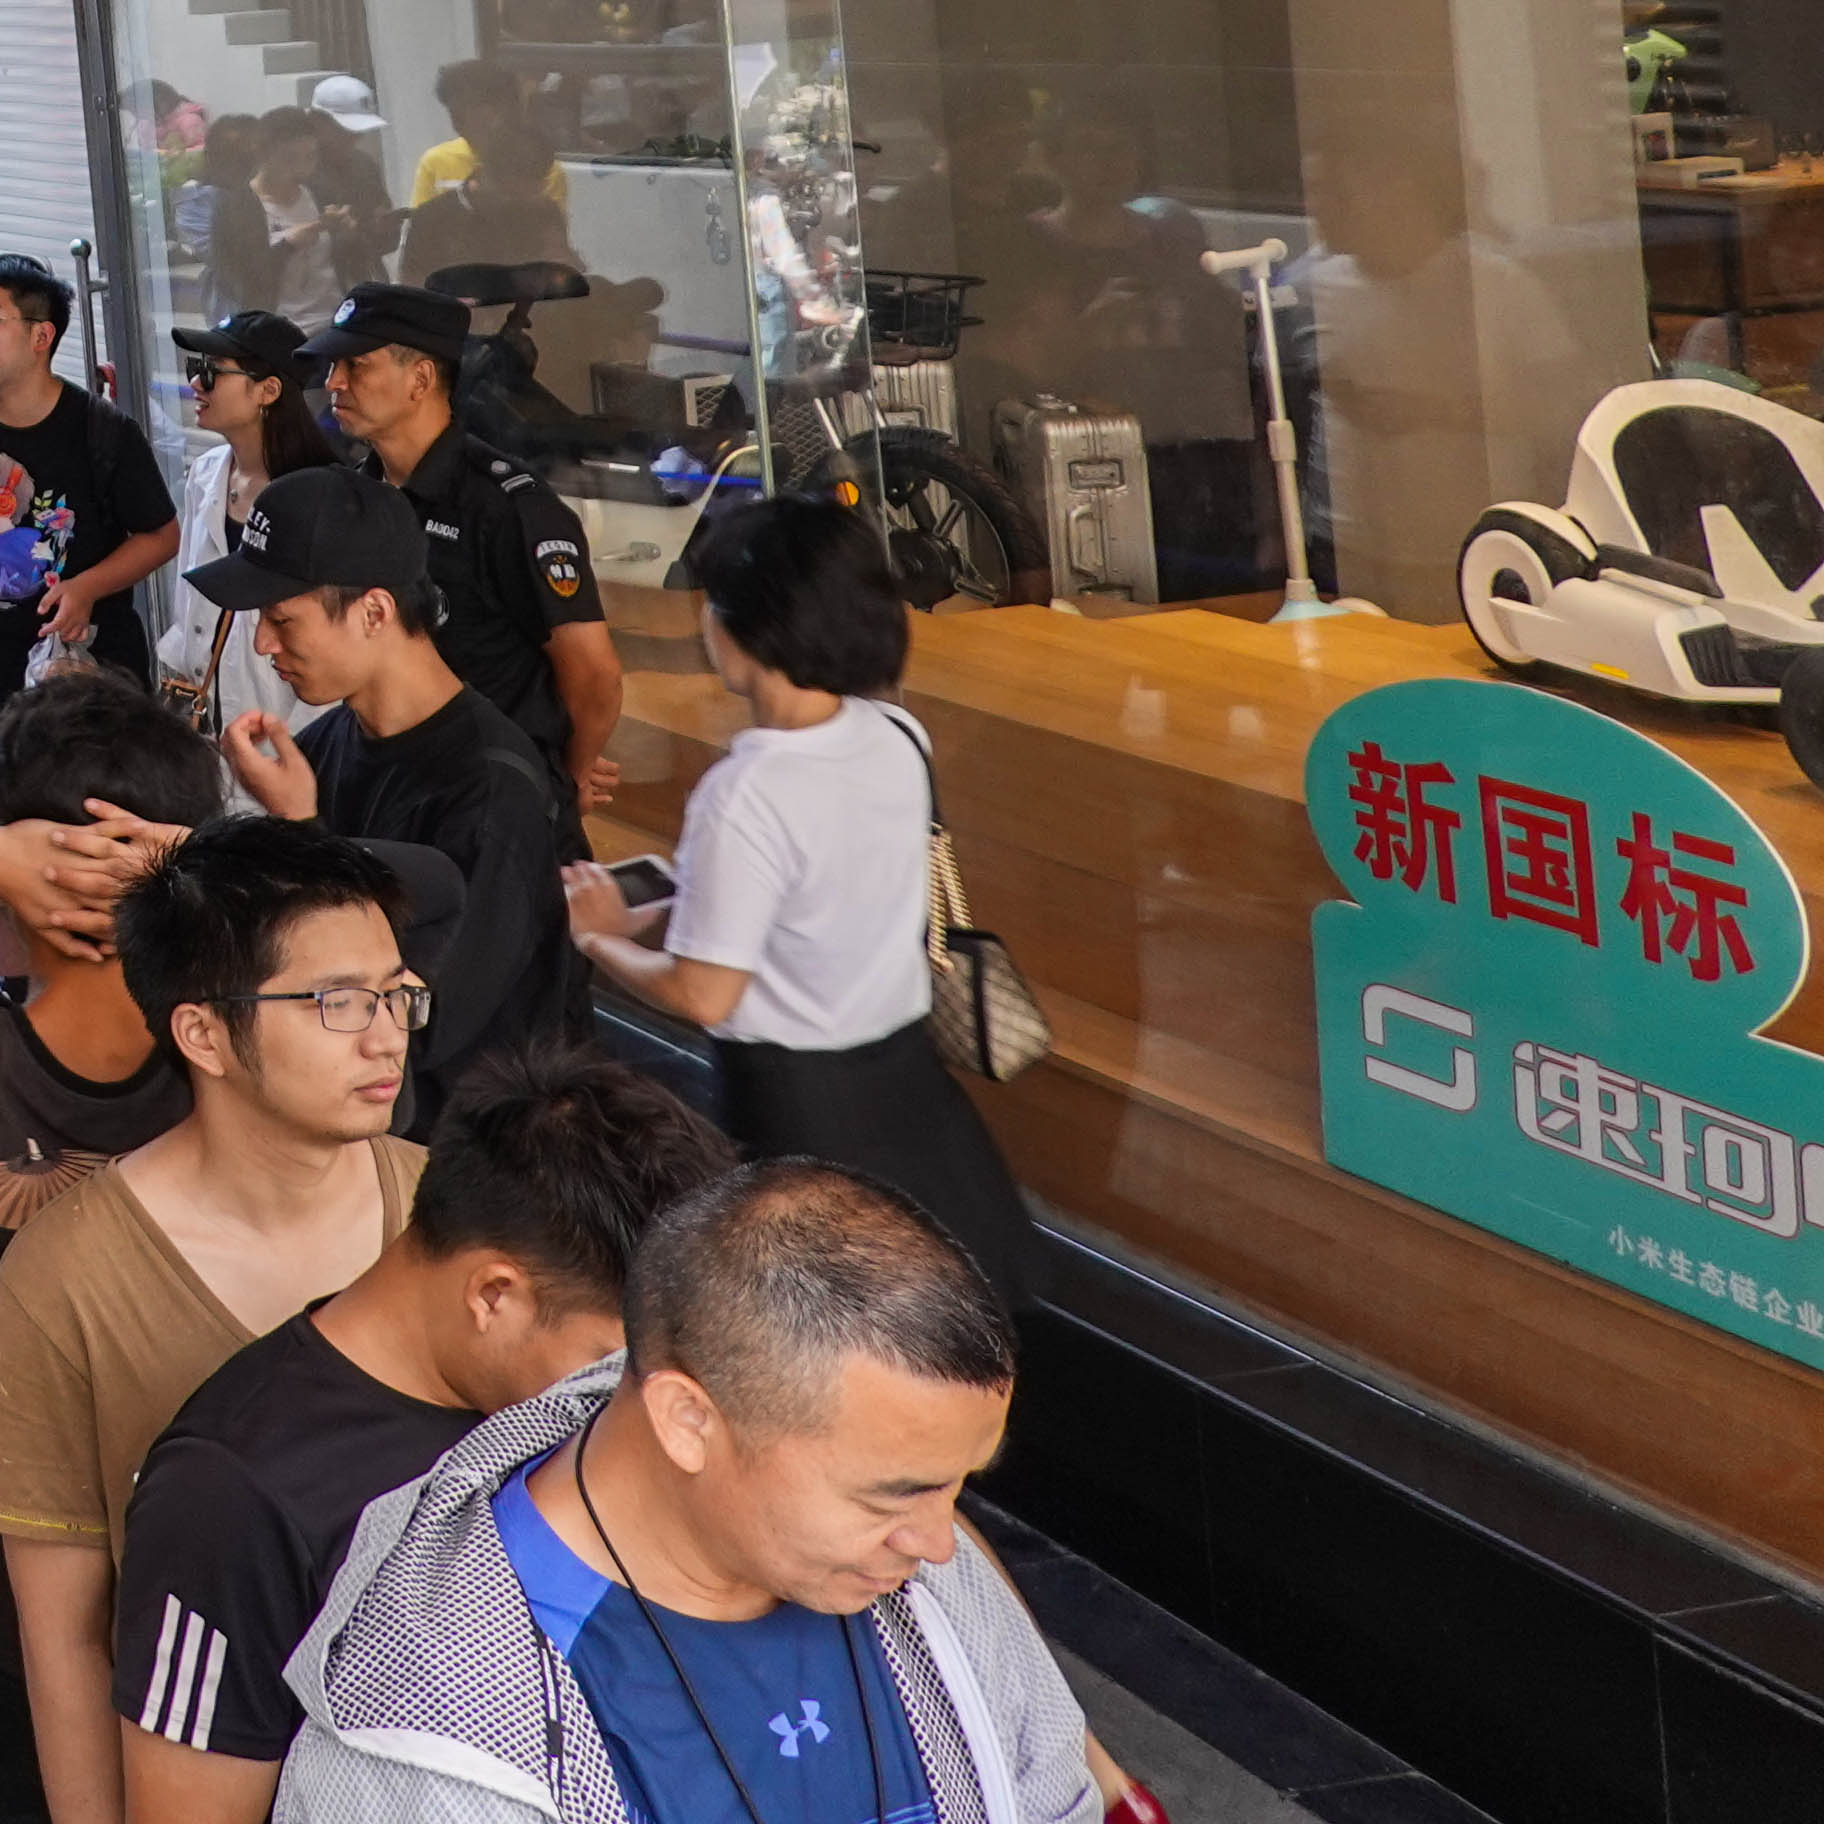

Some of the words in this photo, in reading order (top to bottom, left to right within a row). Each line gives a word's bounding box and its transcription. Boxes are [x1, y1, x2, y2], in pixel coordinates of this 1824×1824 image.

[1347, 740, 1756, 983] 新国标
[1511, 1039, 1824, 1239] 速珂
[1607, 1222, 1824, 1341] 小米生态链企业
